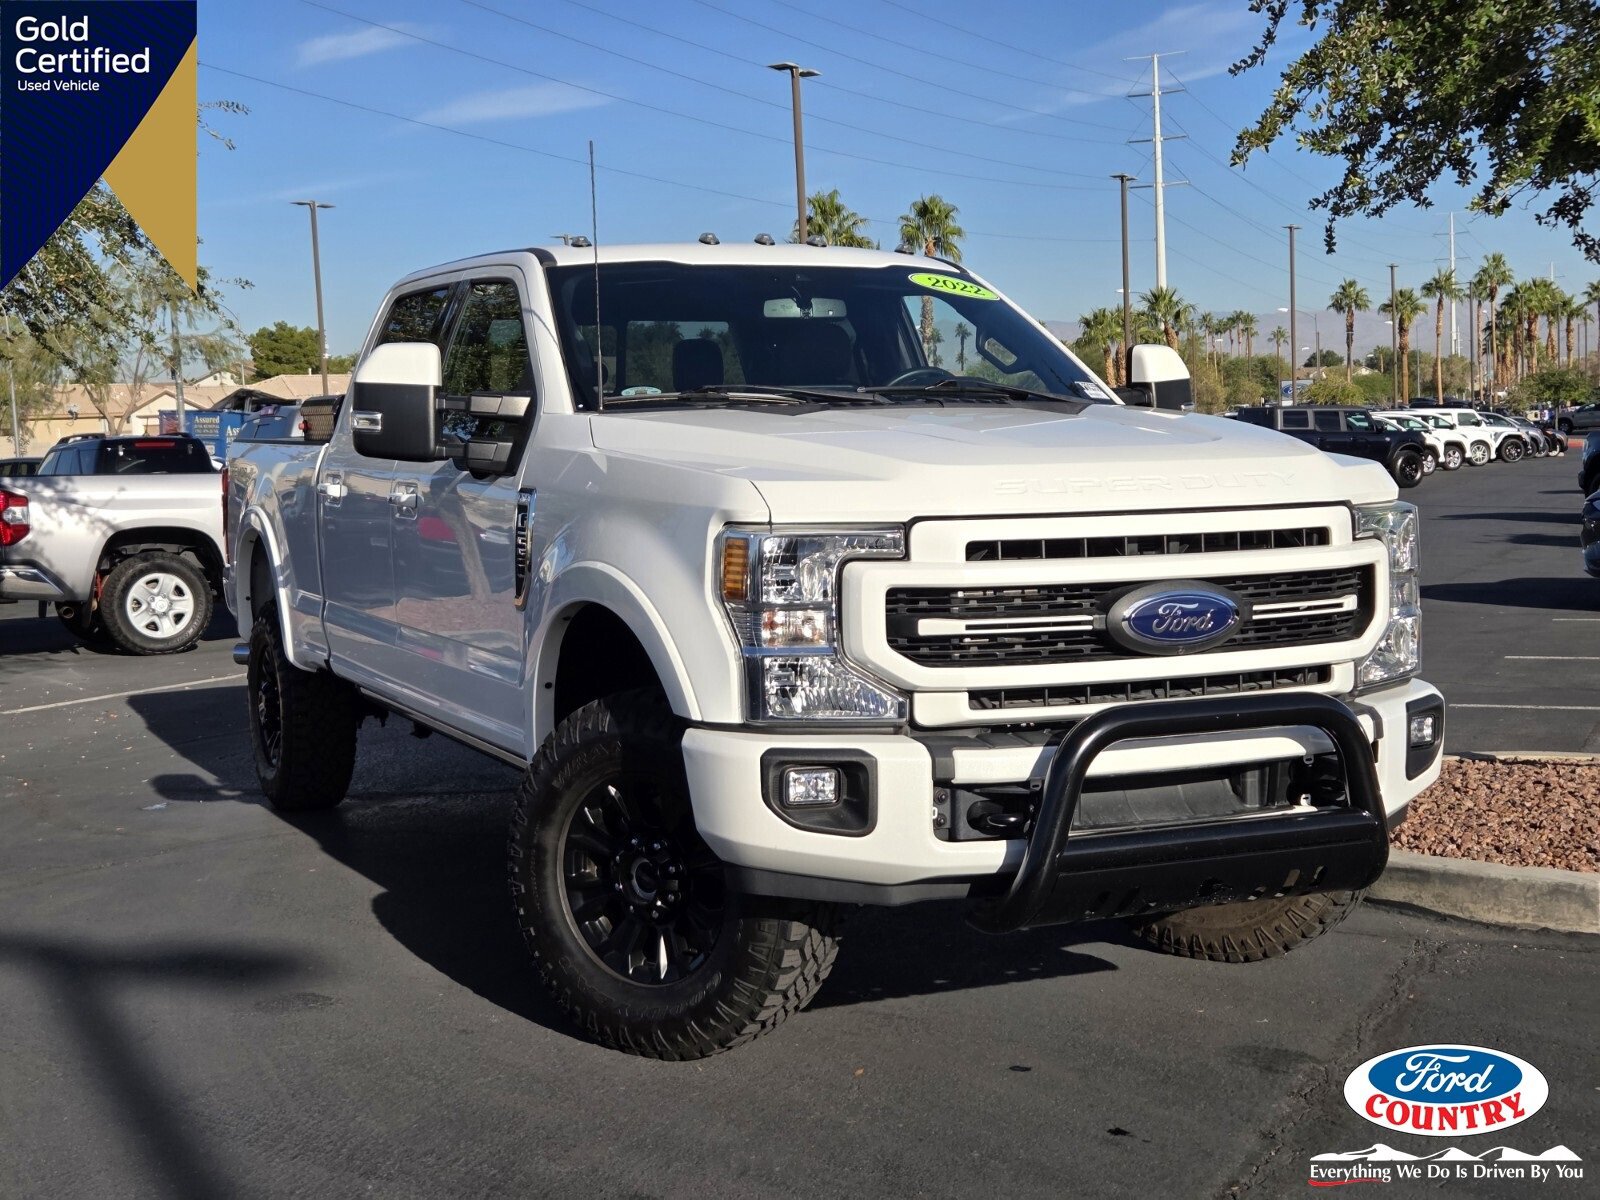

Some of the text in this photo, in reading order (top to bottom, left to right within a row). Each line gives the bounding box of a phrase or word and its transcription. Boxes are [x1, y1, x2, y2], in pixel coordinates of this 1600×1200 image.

[927, 275, 986, 297] 2022
[194, 415, 220, 424] Assured
[993, 471, 1296, 496] SUPER DUTY
[1151, 602, 1215, 634] Ford
